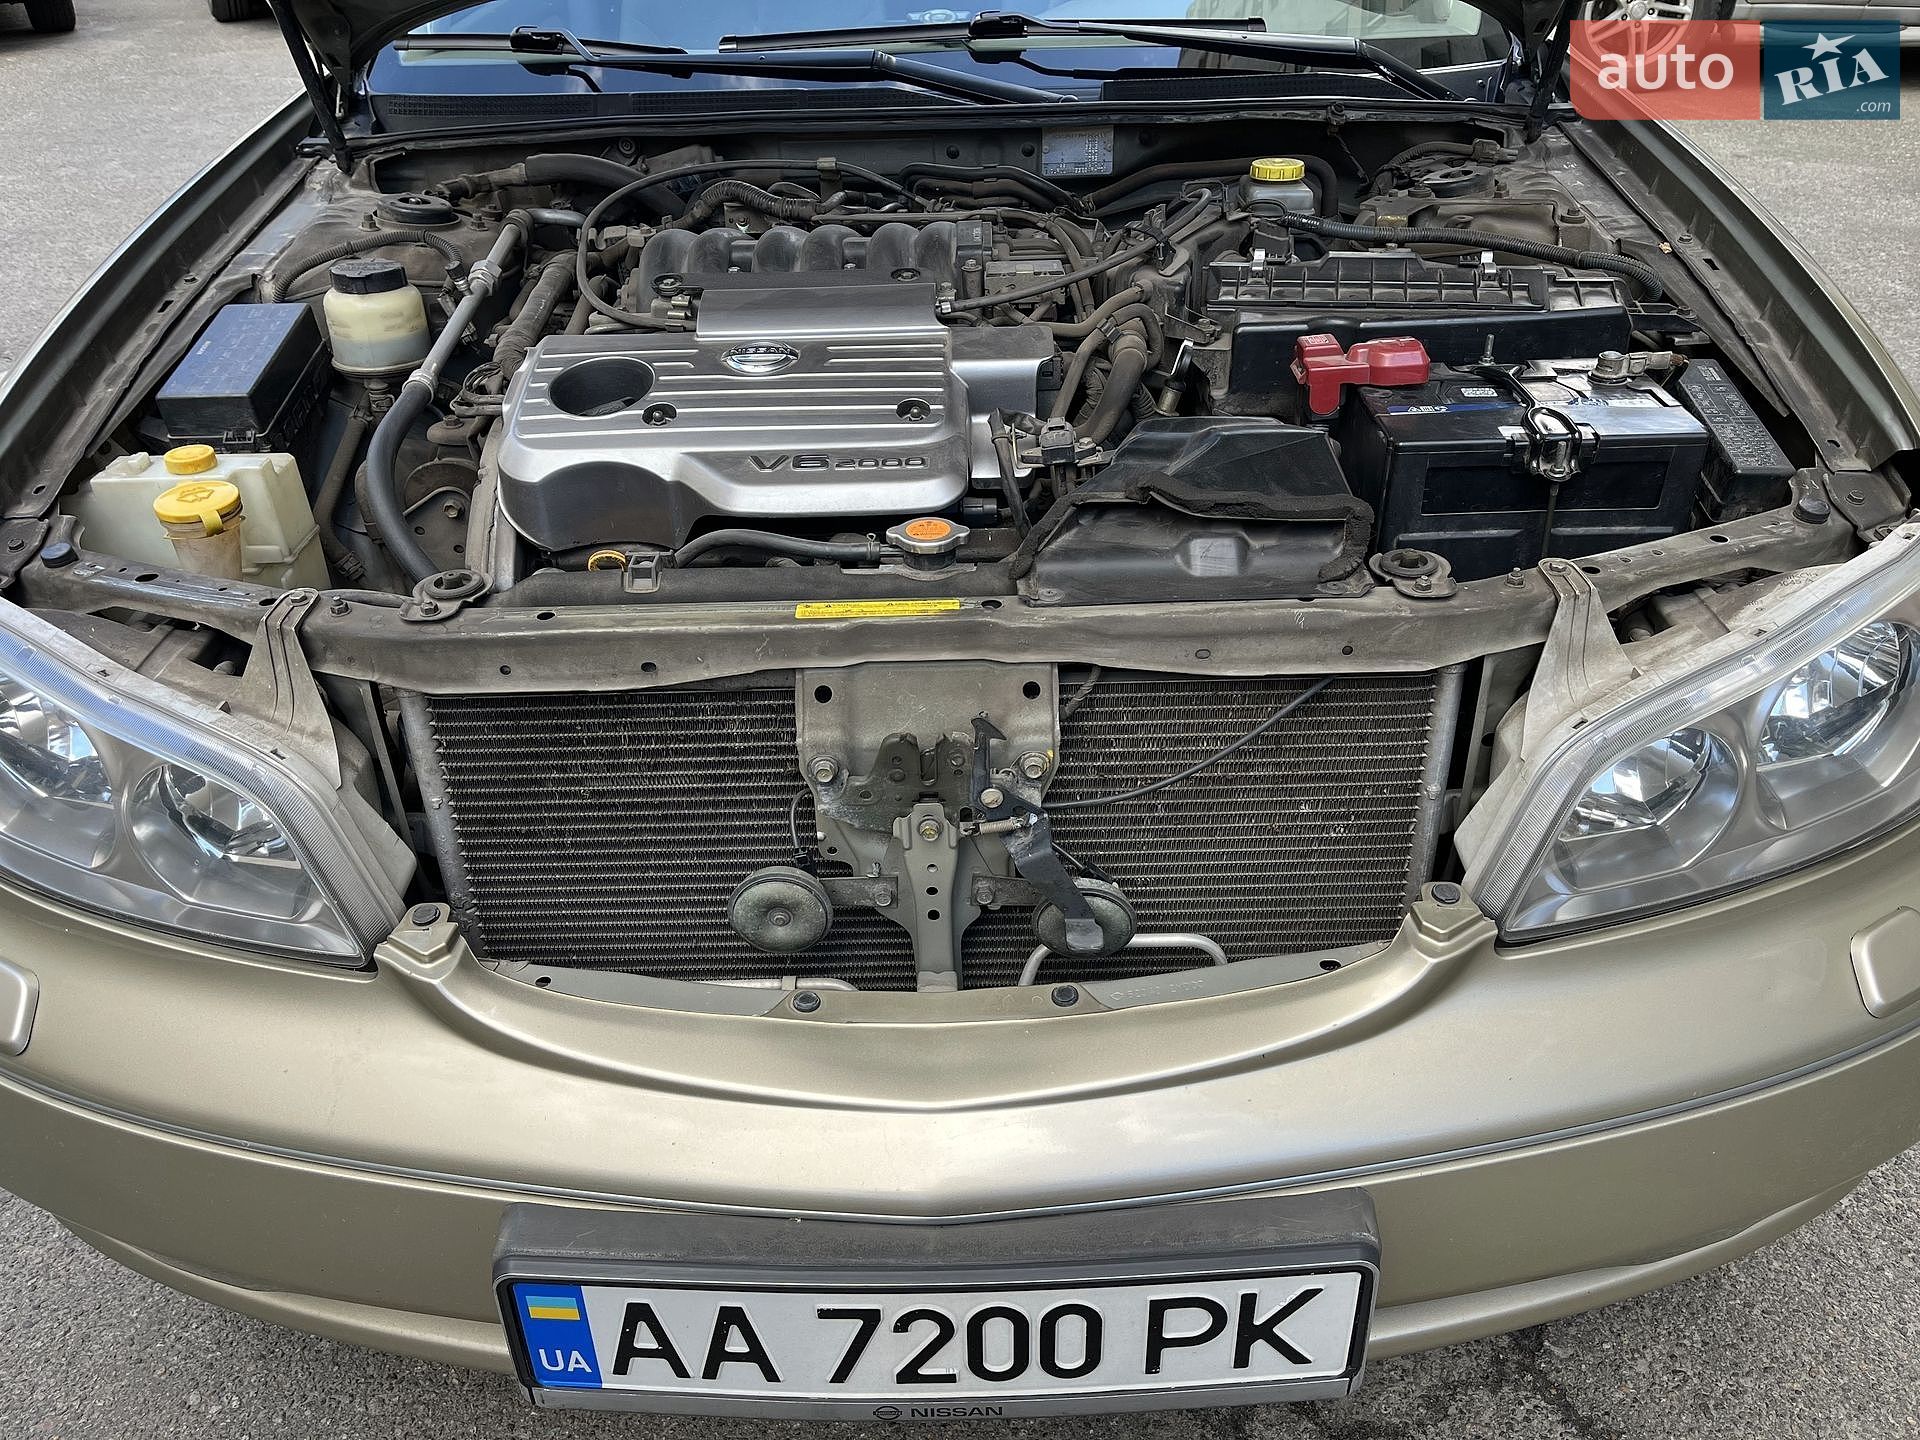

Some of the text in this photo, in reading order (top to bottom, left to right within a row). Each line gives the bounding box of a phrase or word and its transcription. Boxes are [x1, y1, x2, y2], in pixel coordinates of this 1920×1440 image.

[748, 455, 930, 473] V6 2000
[612, 1286, 1325, 1385] AA 7200 PK
[538, 1348, 593, 1373] UA
[911, 1406, 1003, 1418] NISSAN
